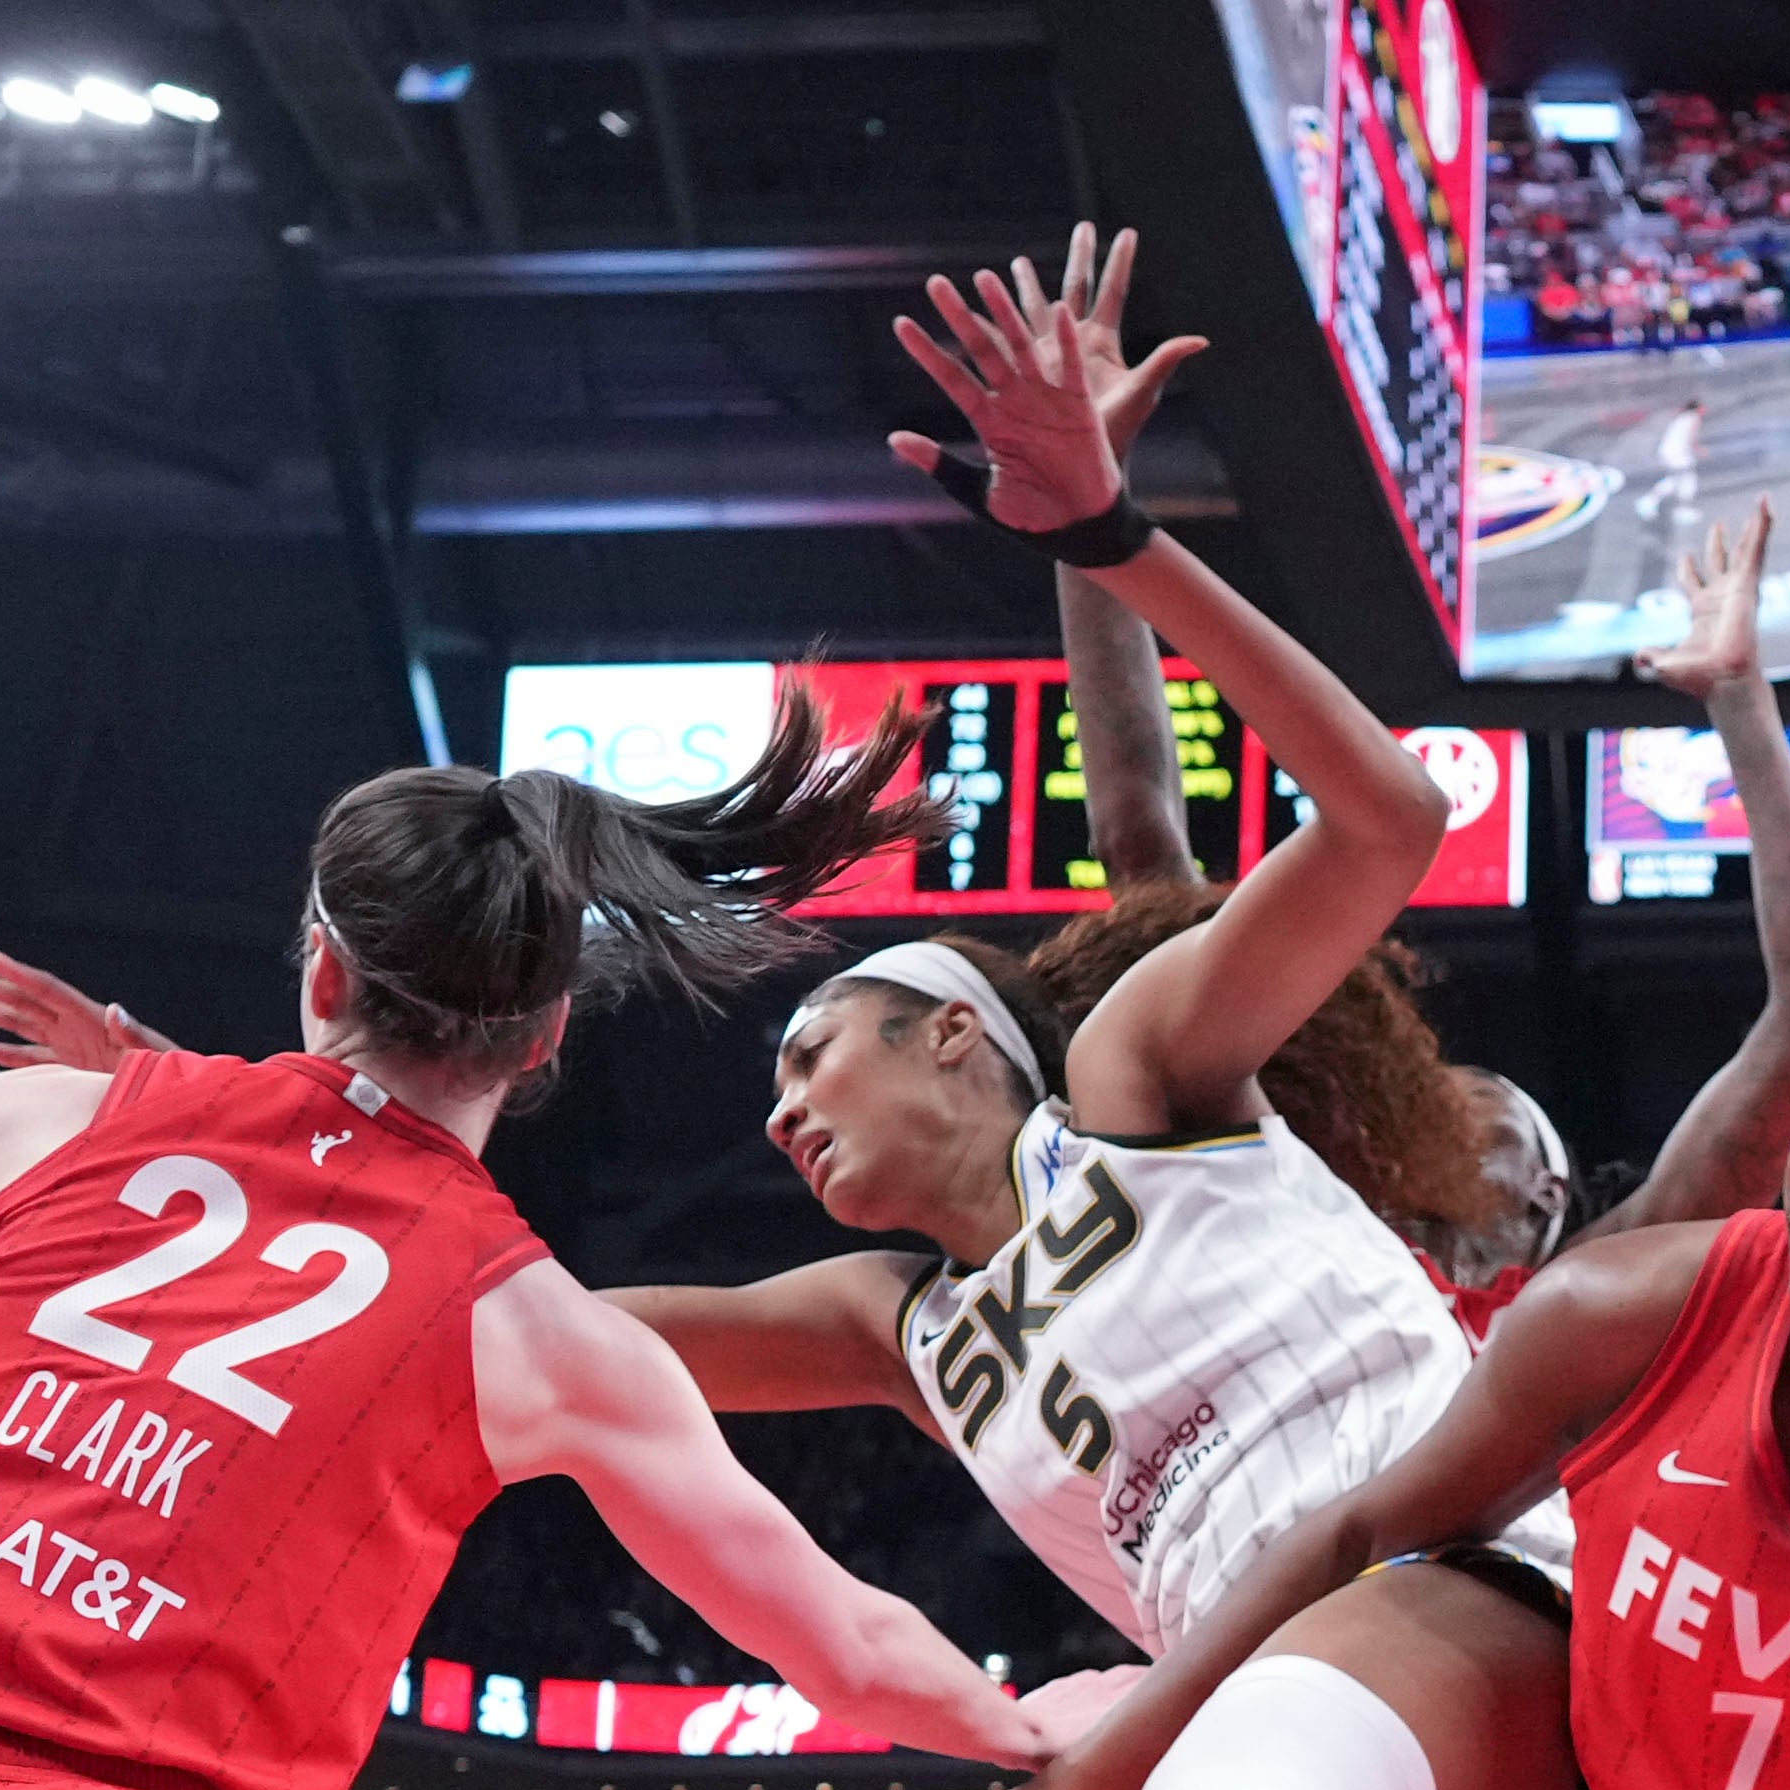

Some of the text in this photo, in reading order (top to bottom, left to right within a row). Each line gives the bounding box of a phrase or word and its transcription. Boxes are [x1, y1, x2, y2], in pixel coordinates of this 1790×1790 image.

[27, 1154, 390, 1437] 22
[936, 1156, 1142, 1456] SKY
[1040, 1356, 1117, 1480] 5
[1121, 1428, 1231, 1565] Medicine
